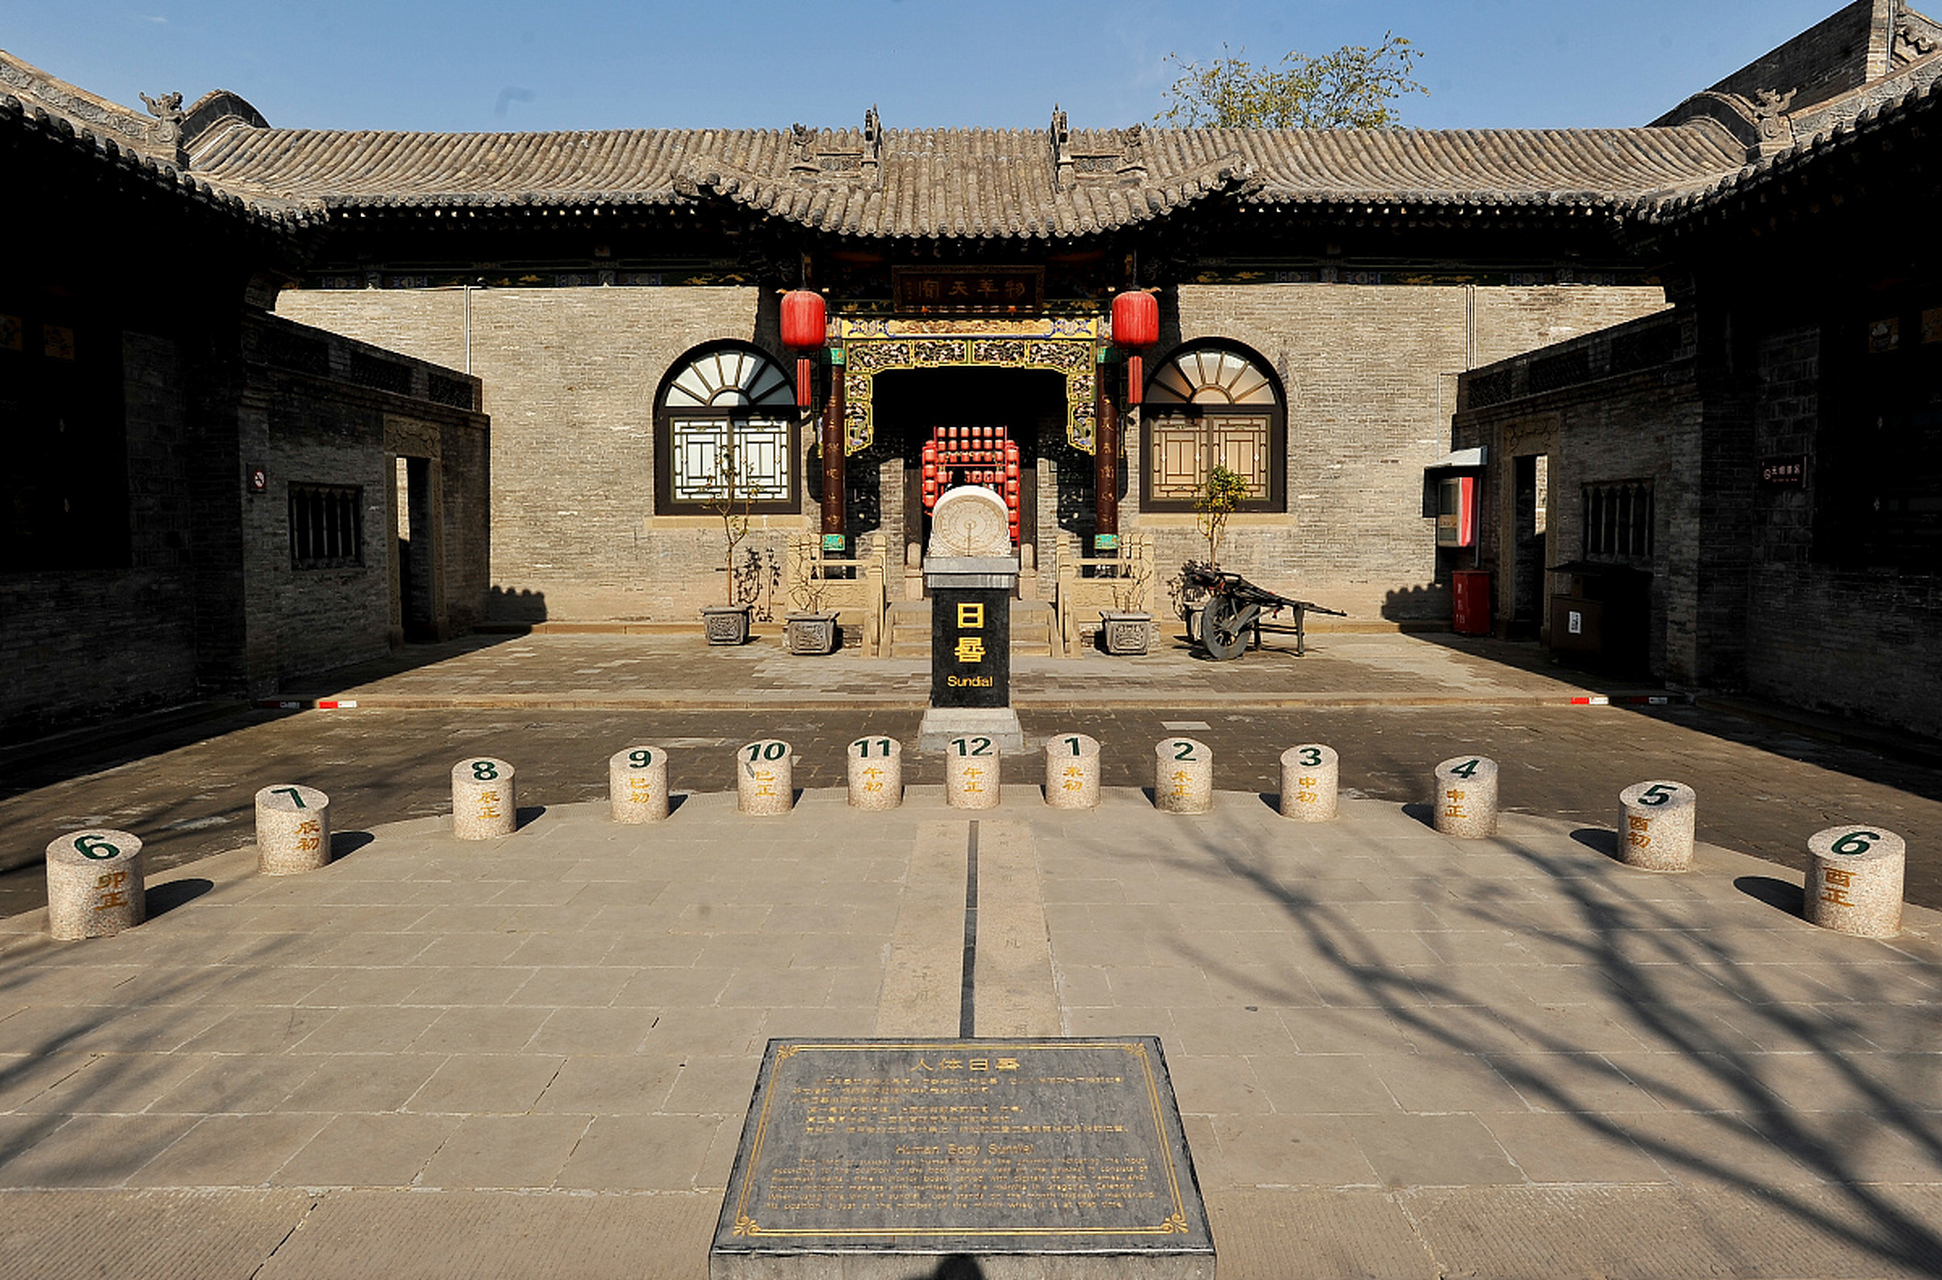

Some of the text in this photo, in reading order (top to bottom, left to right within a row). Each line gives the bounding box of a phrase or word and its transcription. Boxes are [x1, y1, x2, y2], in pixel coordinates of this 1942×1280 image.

[956, 603, 985, 663] 日晷
[946, 675, 993, 690] Sundial
[750, 742, 786, 761] 10
[855, 739, 891, 758] 11
[956, 737, 991, 757] 12
[1063, 737, 1080, 756] 1
[1172, 741, 1195, 761] 2
[628, 750, 651, 769] 9
[1298, 747, 1322, 767] 3
[472, 760, 499, 781] 8
[1449, 759, 1480, 779] 4
[962, 766, 986, 793] 午正
[271, 787, 307, 809] 7
[1636, 783, 1674, 806] 5
[74, 834, 122, 860] 6
[1829, 831, 1881, 857] 6
[909, 1057, 1021, 1072] 人体日晷
[896, 1143, 1034, 1157] Human Body Sundial
